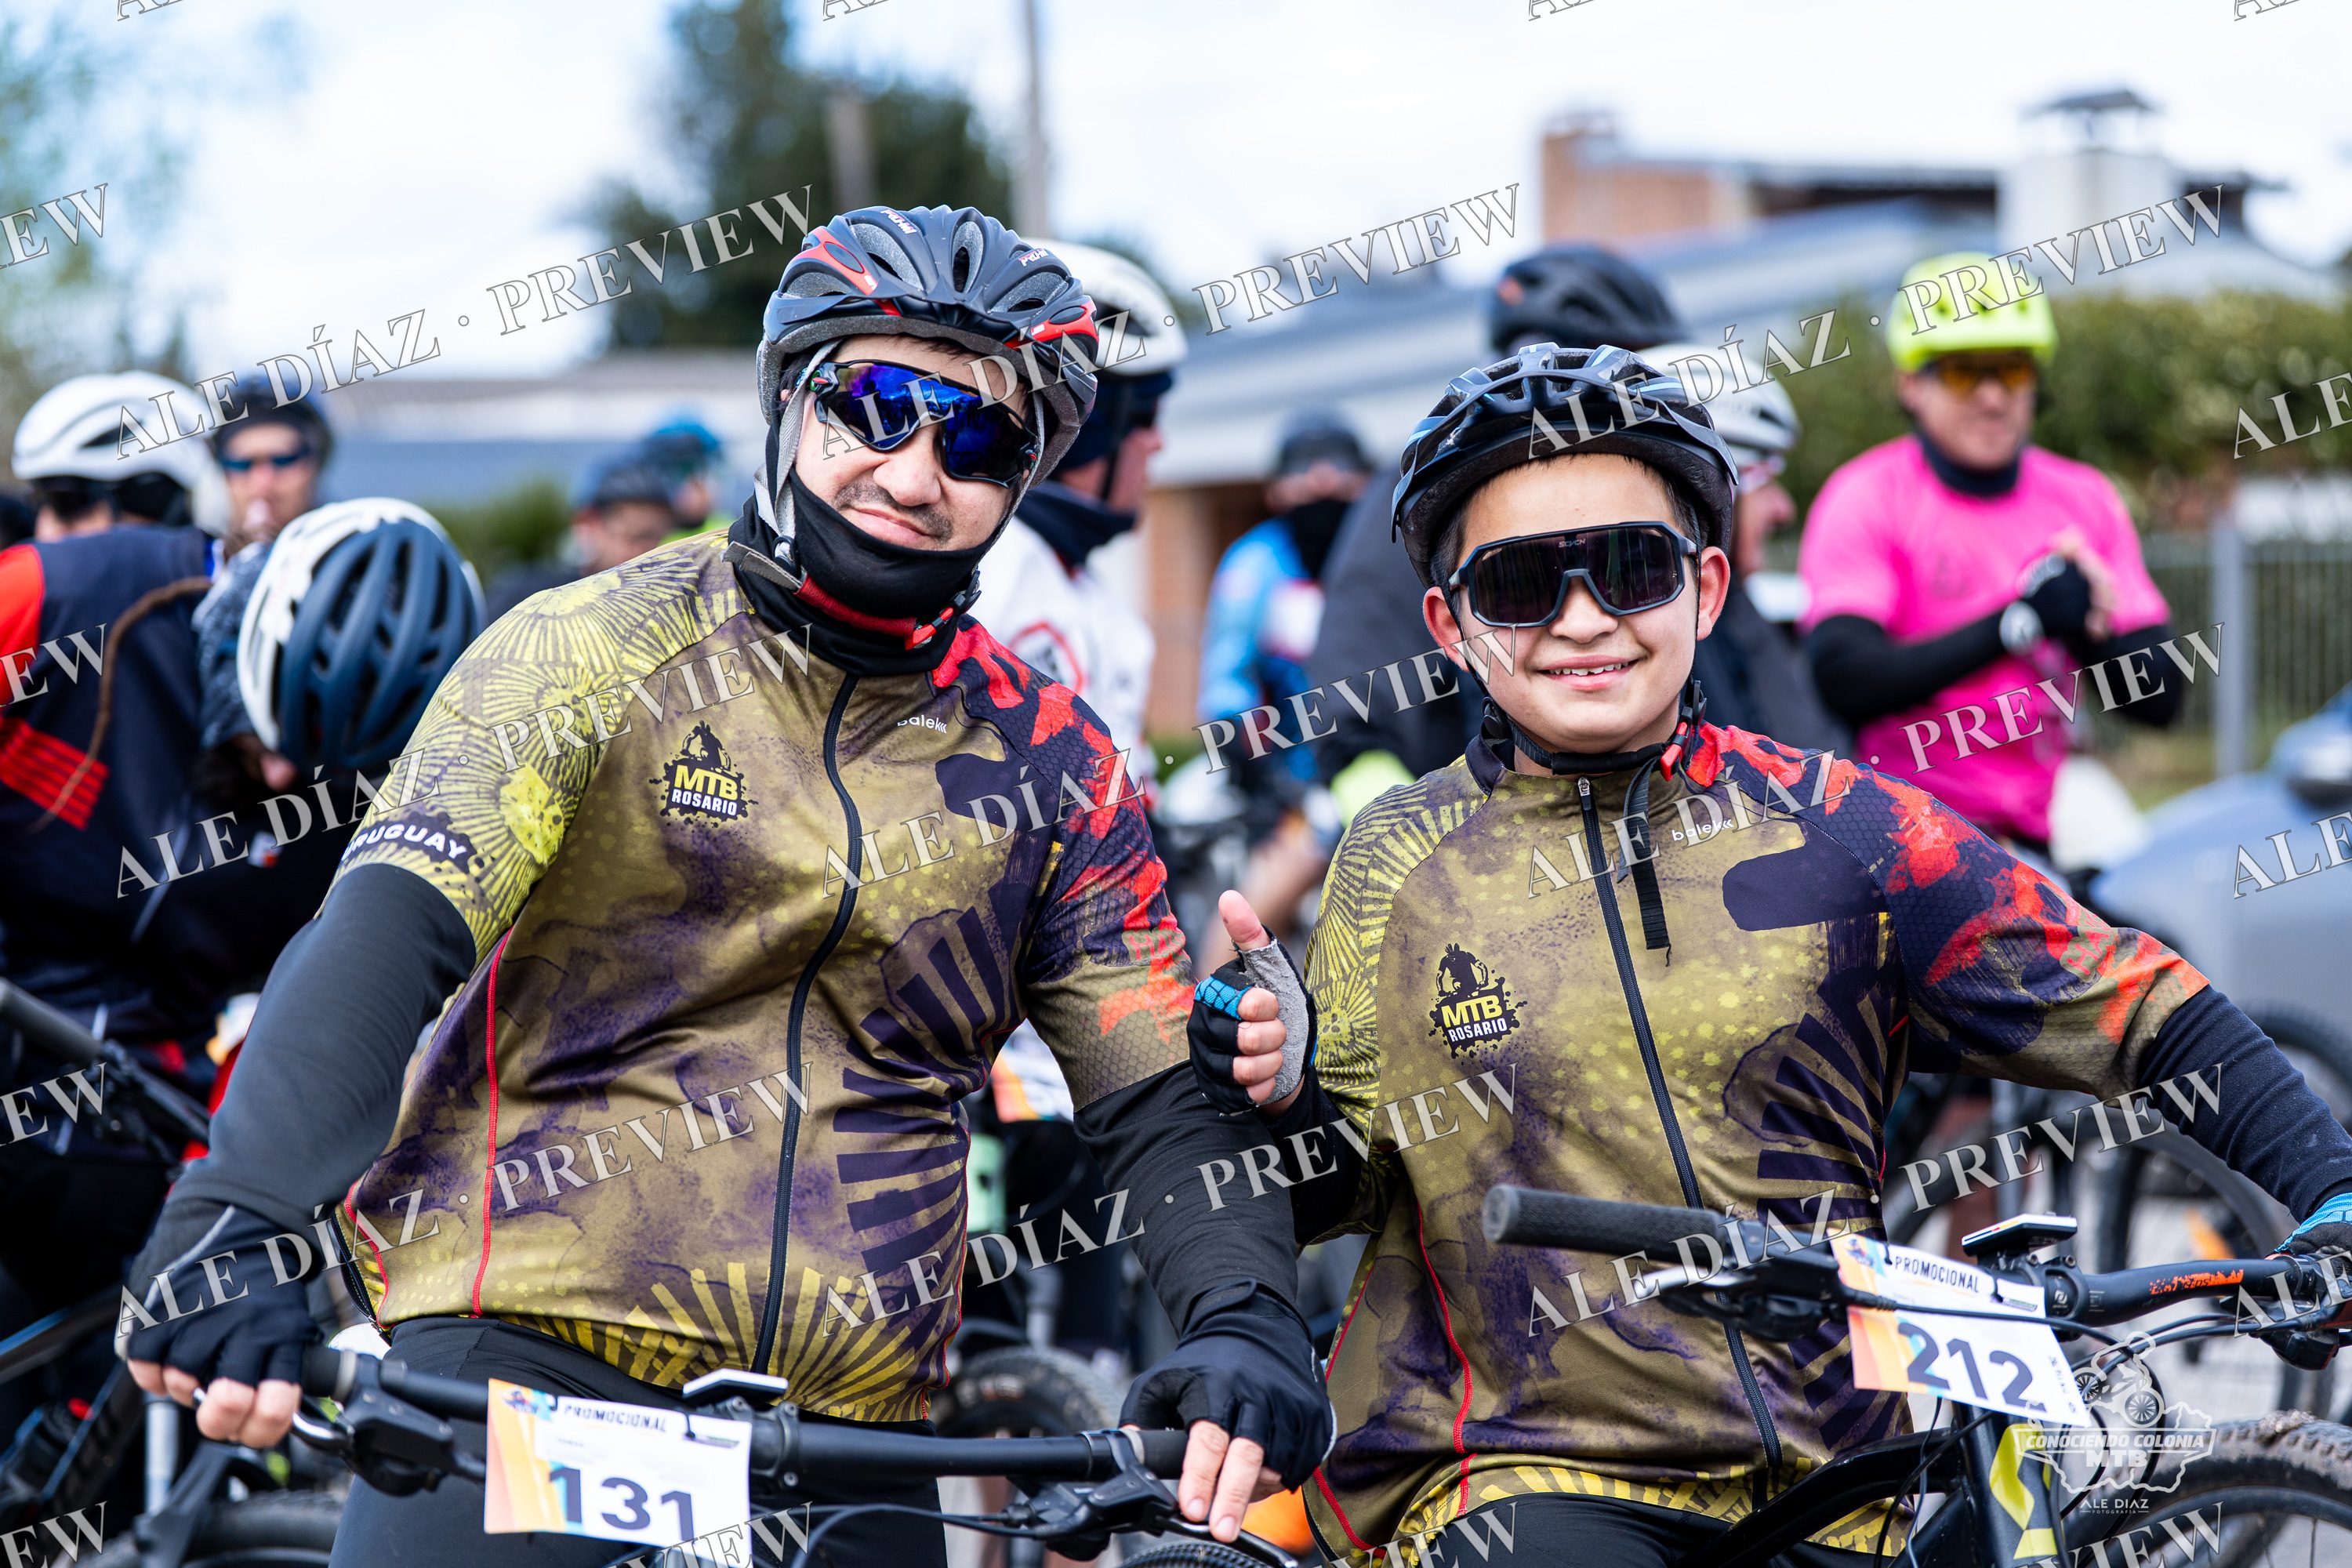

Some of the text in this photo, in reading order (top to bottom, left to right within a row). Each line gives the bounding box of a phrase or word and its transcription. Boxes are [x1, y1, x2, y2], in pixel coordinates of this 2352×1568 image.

[674, 764, 738, 800] MTB
[671, 789, 737, 816] ROSARIO
[1441, 994, 1503, 1028] MTB
[1448, 1018, 1508, 1042] ROSARIO
[1895, 1256, 1980, 1293] PROMOCIONAL
[1898, 1323, 2047, 1412] 212
[563, 1405, 667, 1432] PROMOCIONAL
[549, 1466, 695, 1541] 131
